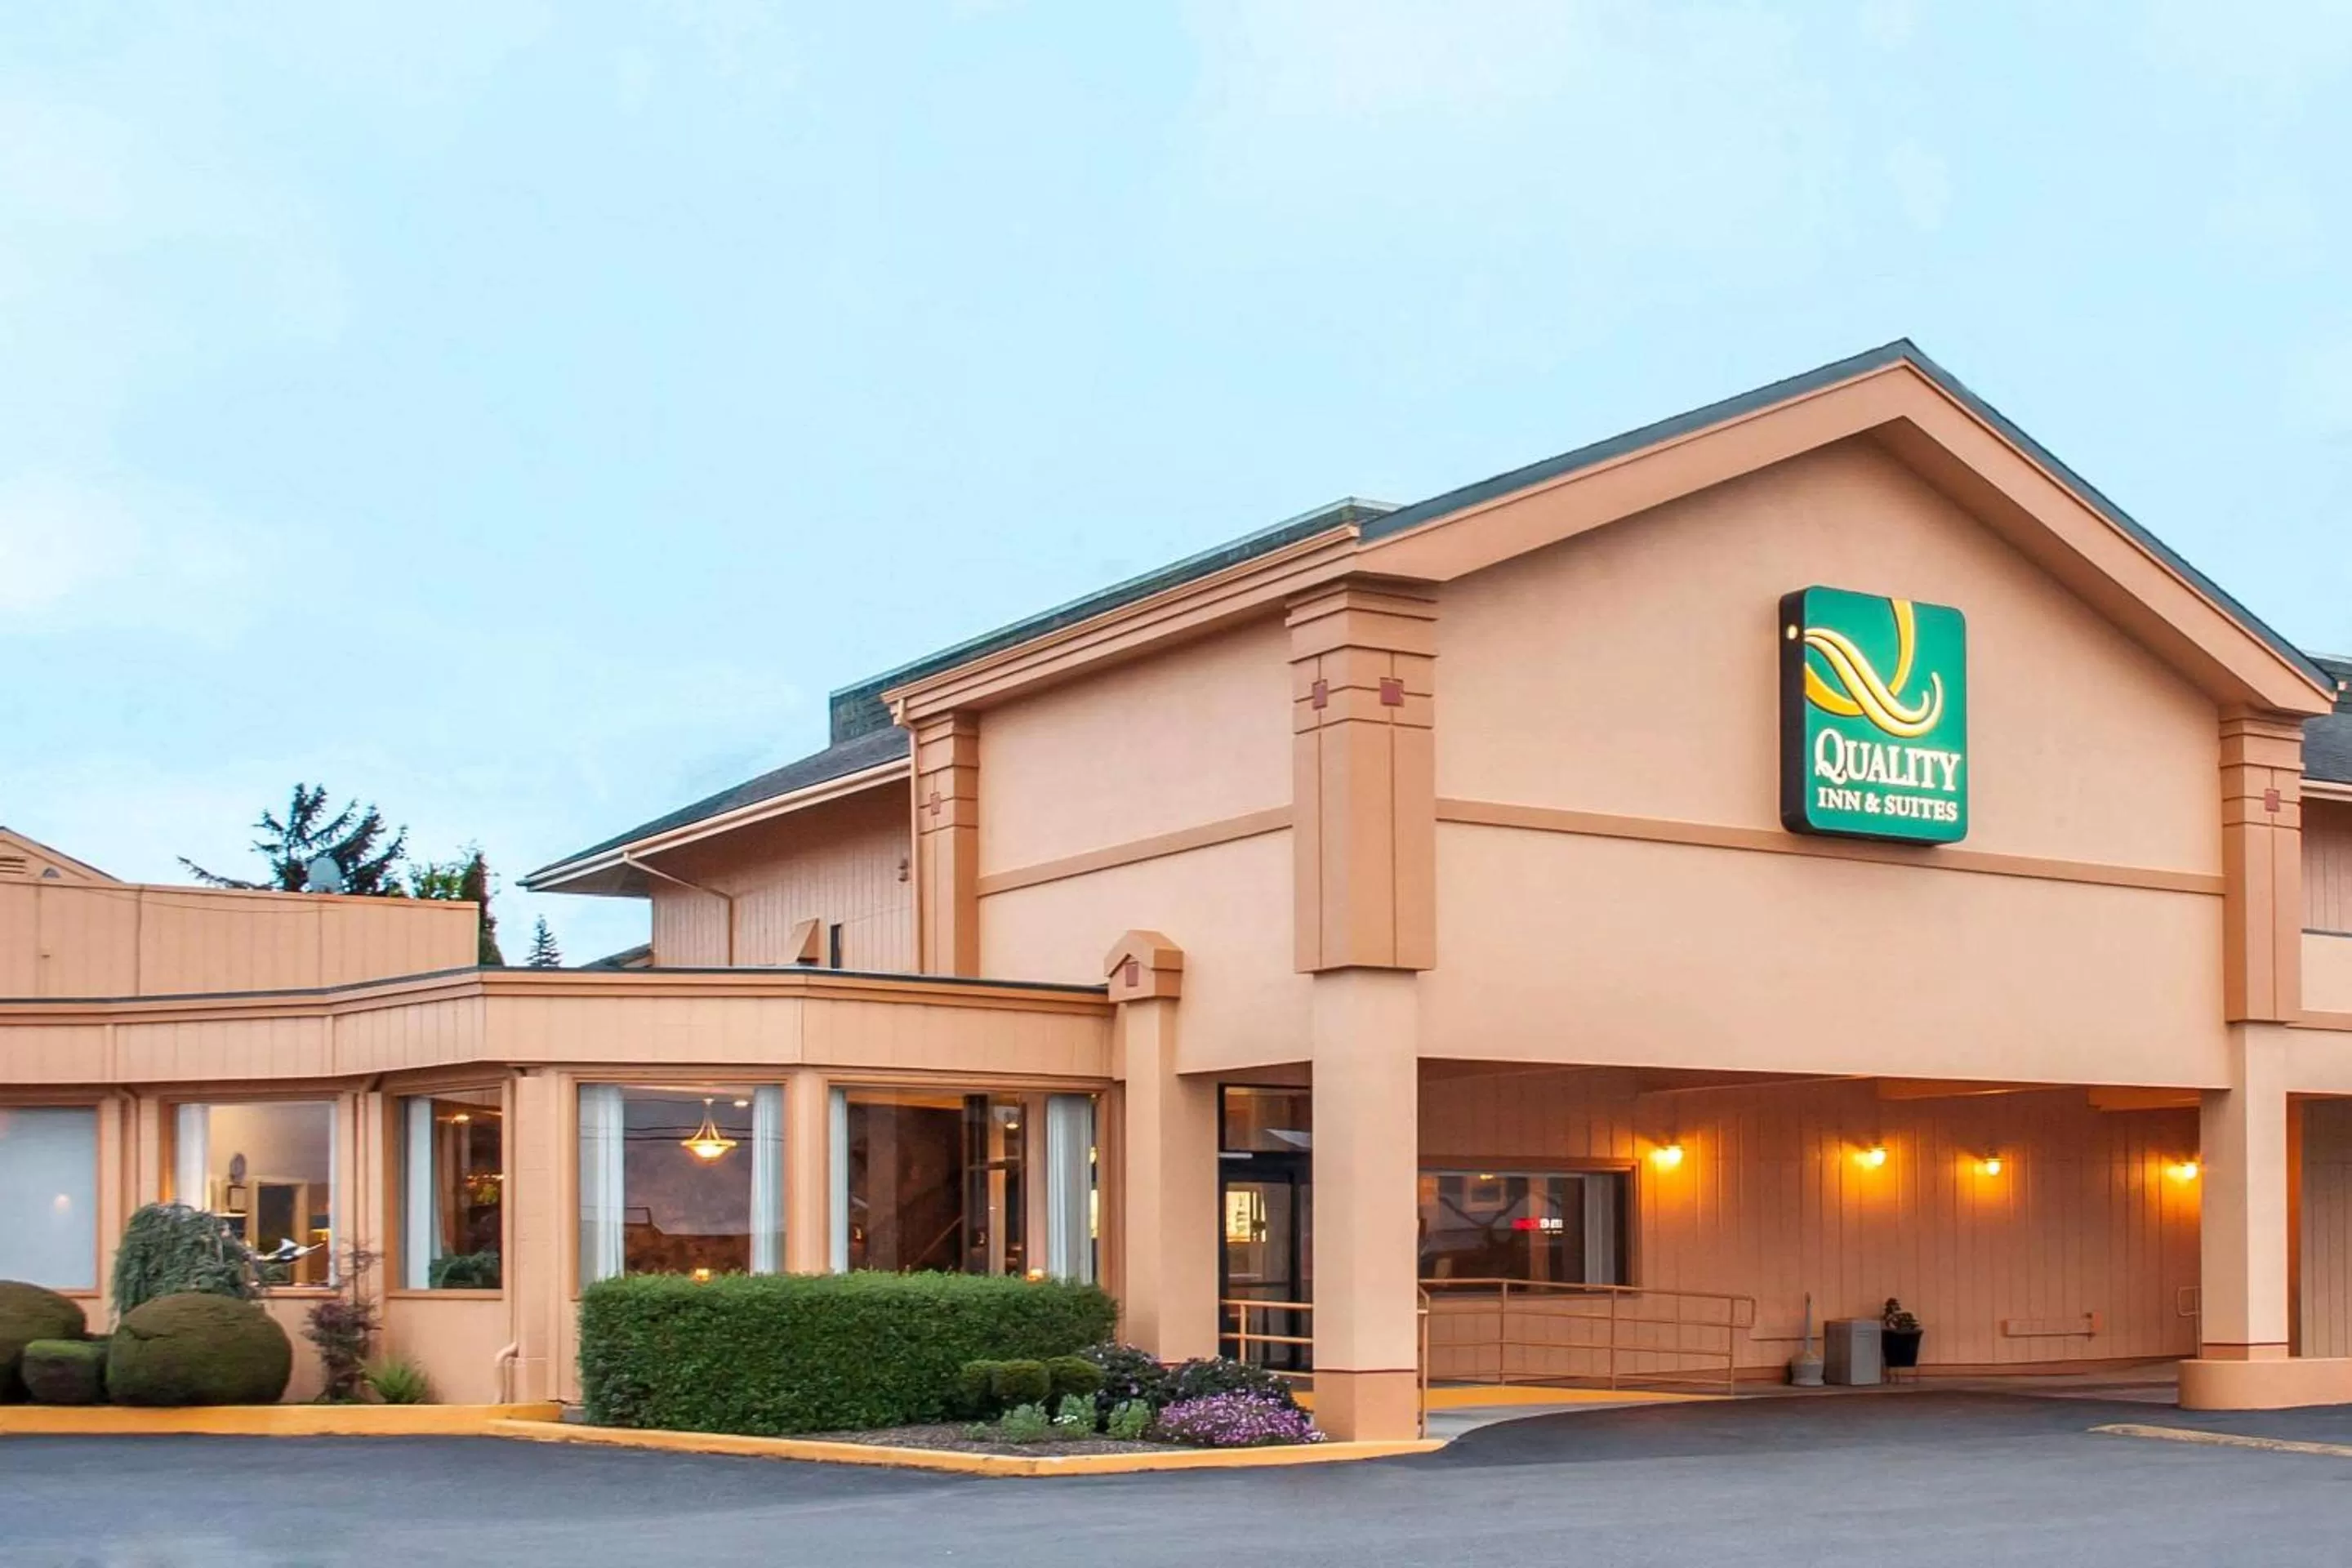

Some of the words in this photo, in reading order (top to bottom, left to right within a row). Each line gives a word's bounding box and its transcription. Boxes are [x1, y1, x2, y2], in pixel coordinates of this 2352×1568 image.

[1815, 728, 1961, 791] QUALITY
[1818, 787, 1860, 811] INN
[1865, 792, 1881, 813] &
[1884, 795, 1958, 822] SUITES
